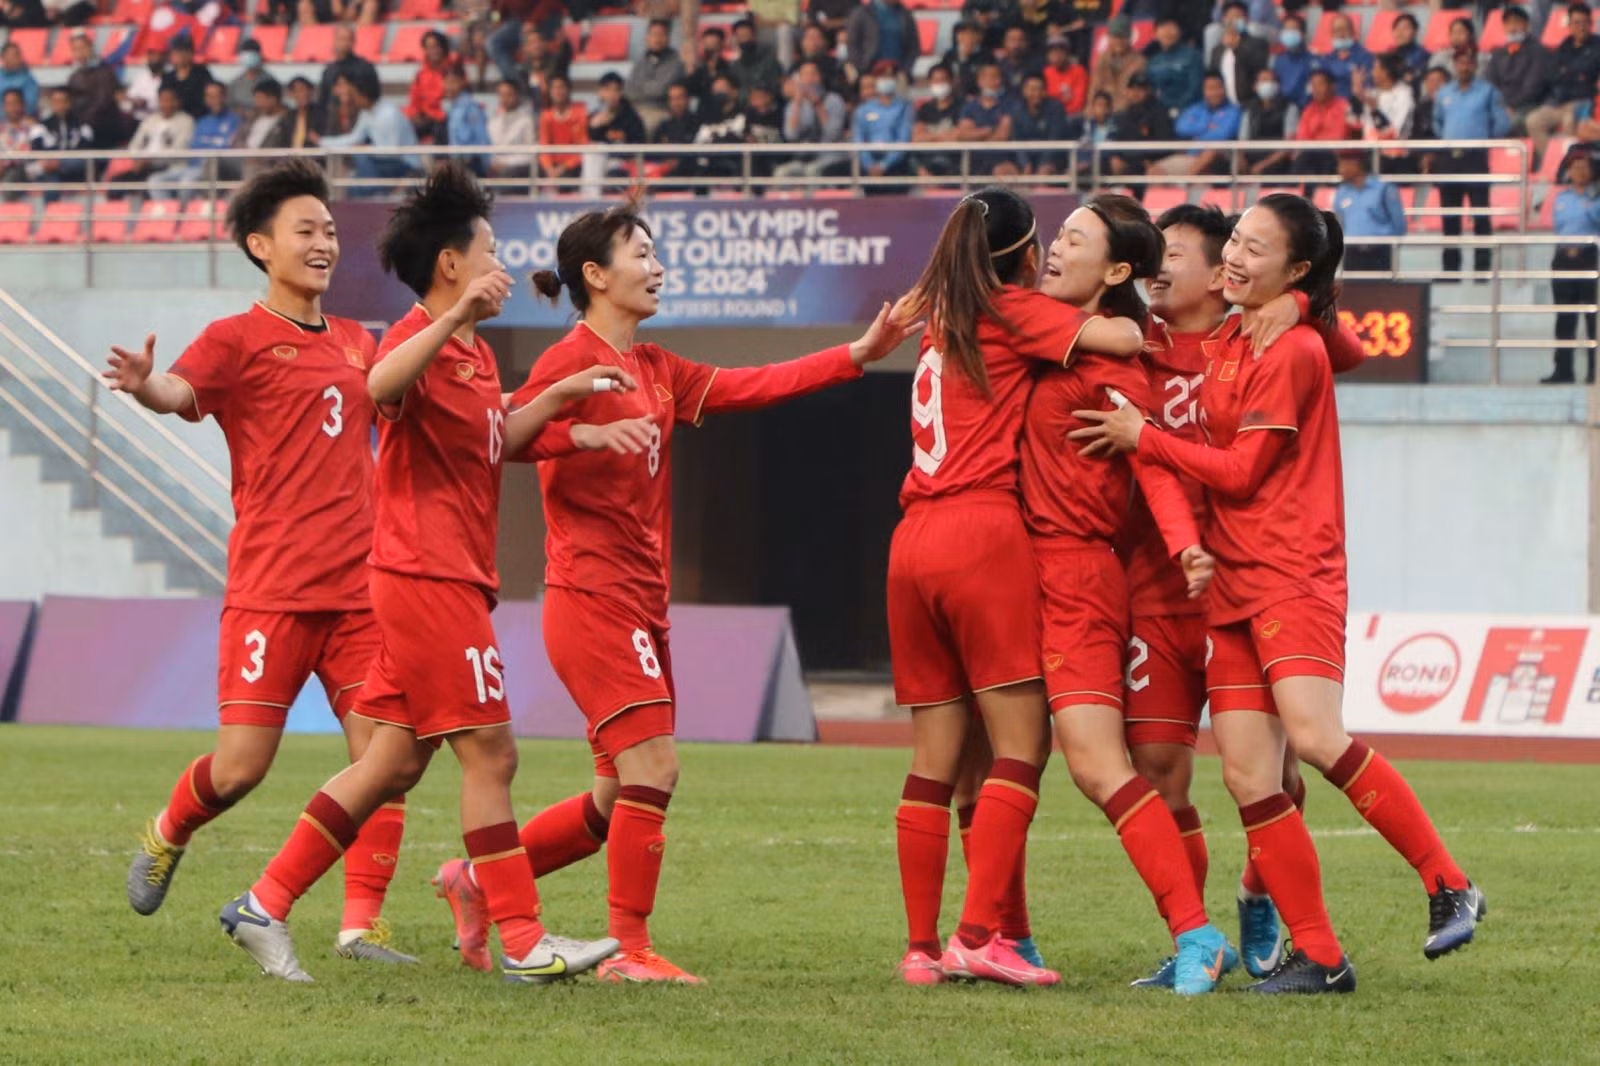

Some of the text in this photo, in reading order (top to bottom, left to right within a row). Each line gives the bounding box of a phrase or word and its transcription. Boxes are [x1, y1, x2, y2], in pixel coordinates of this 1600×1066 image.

[693, 209, 840, 238] OLYMPIC
[663, 236, 891, 267] TOURNAMENT
[692, 267, 768, 295] 2024
[322, 384, 343, 438] 3
[911, 345, 948, 477] 9
[648, 422, 661, 478] 8
[240, 629, 267, 683] 3
[631, 627, 661, 679] 8
